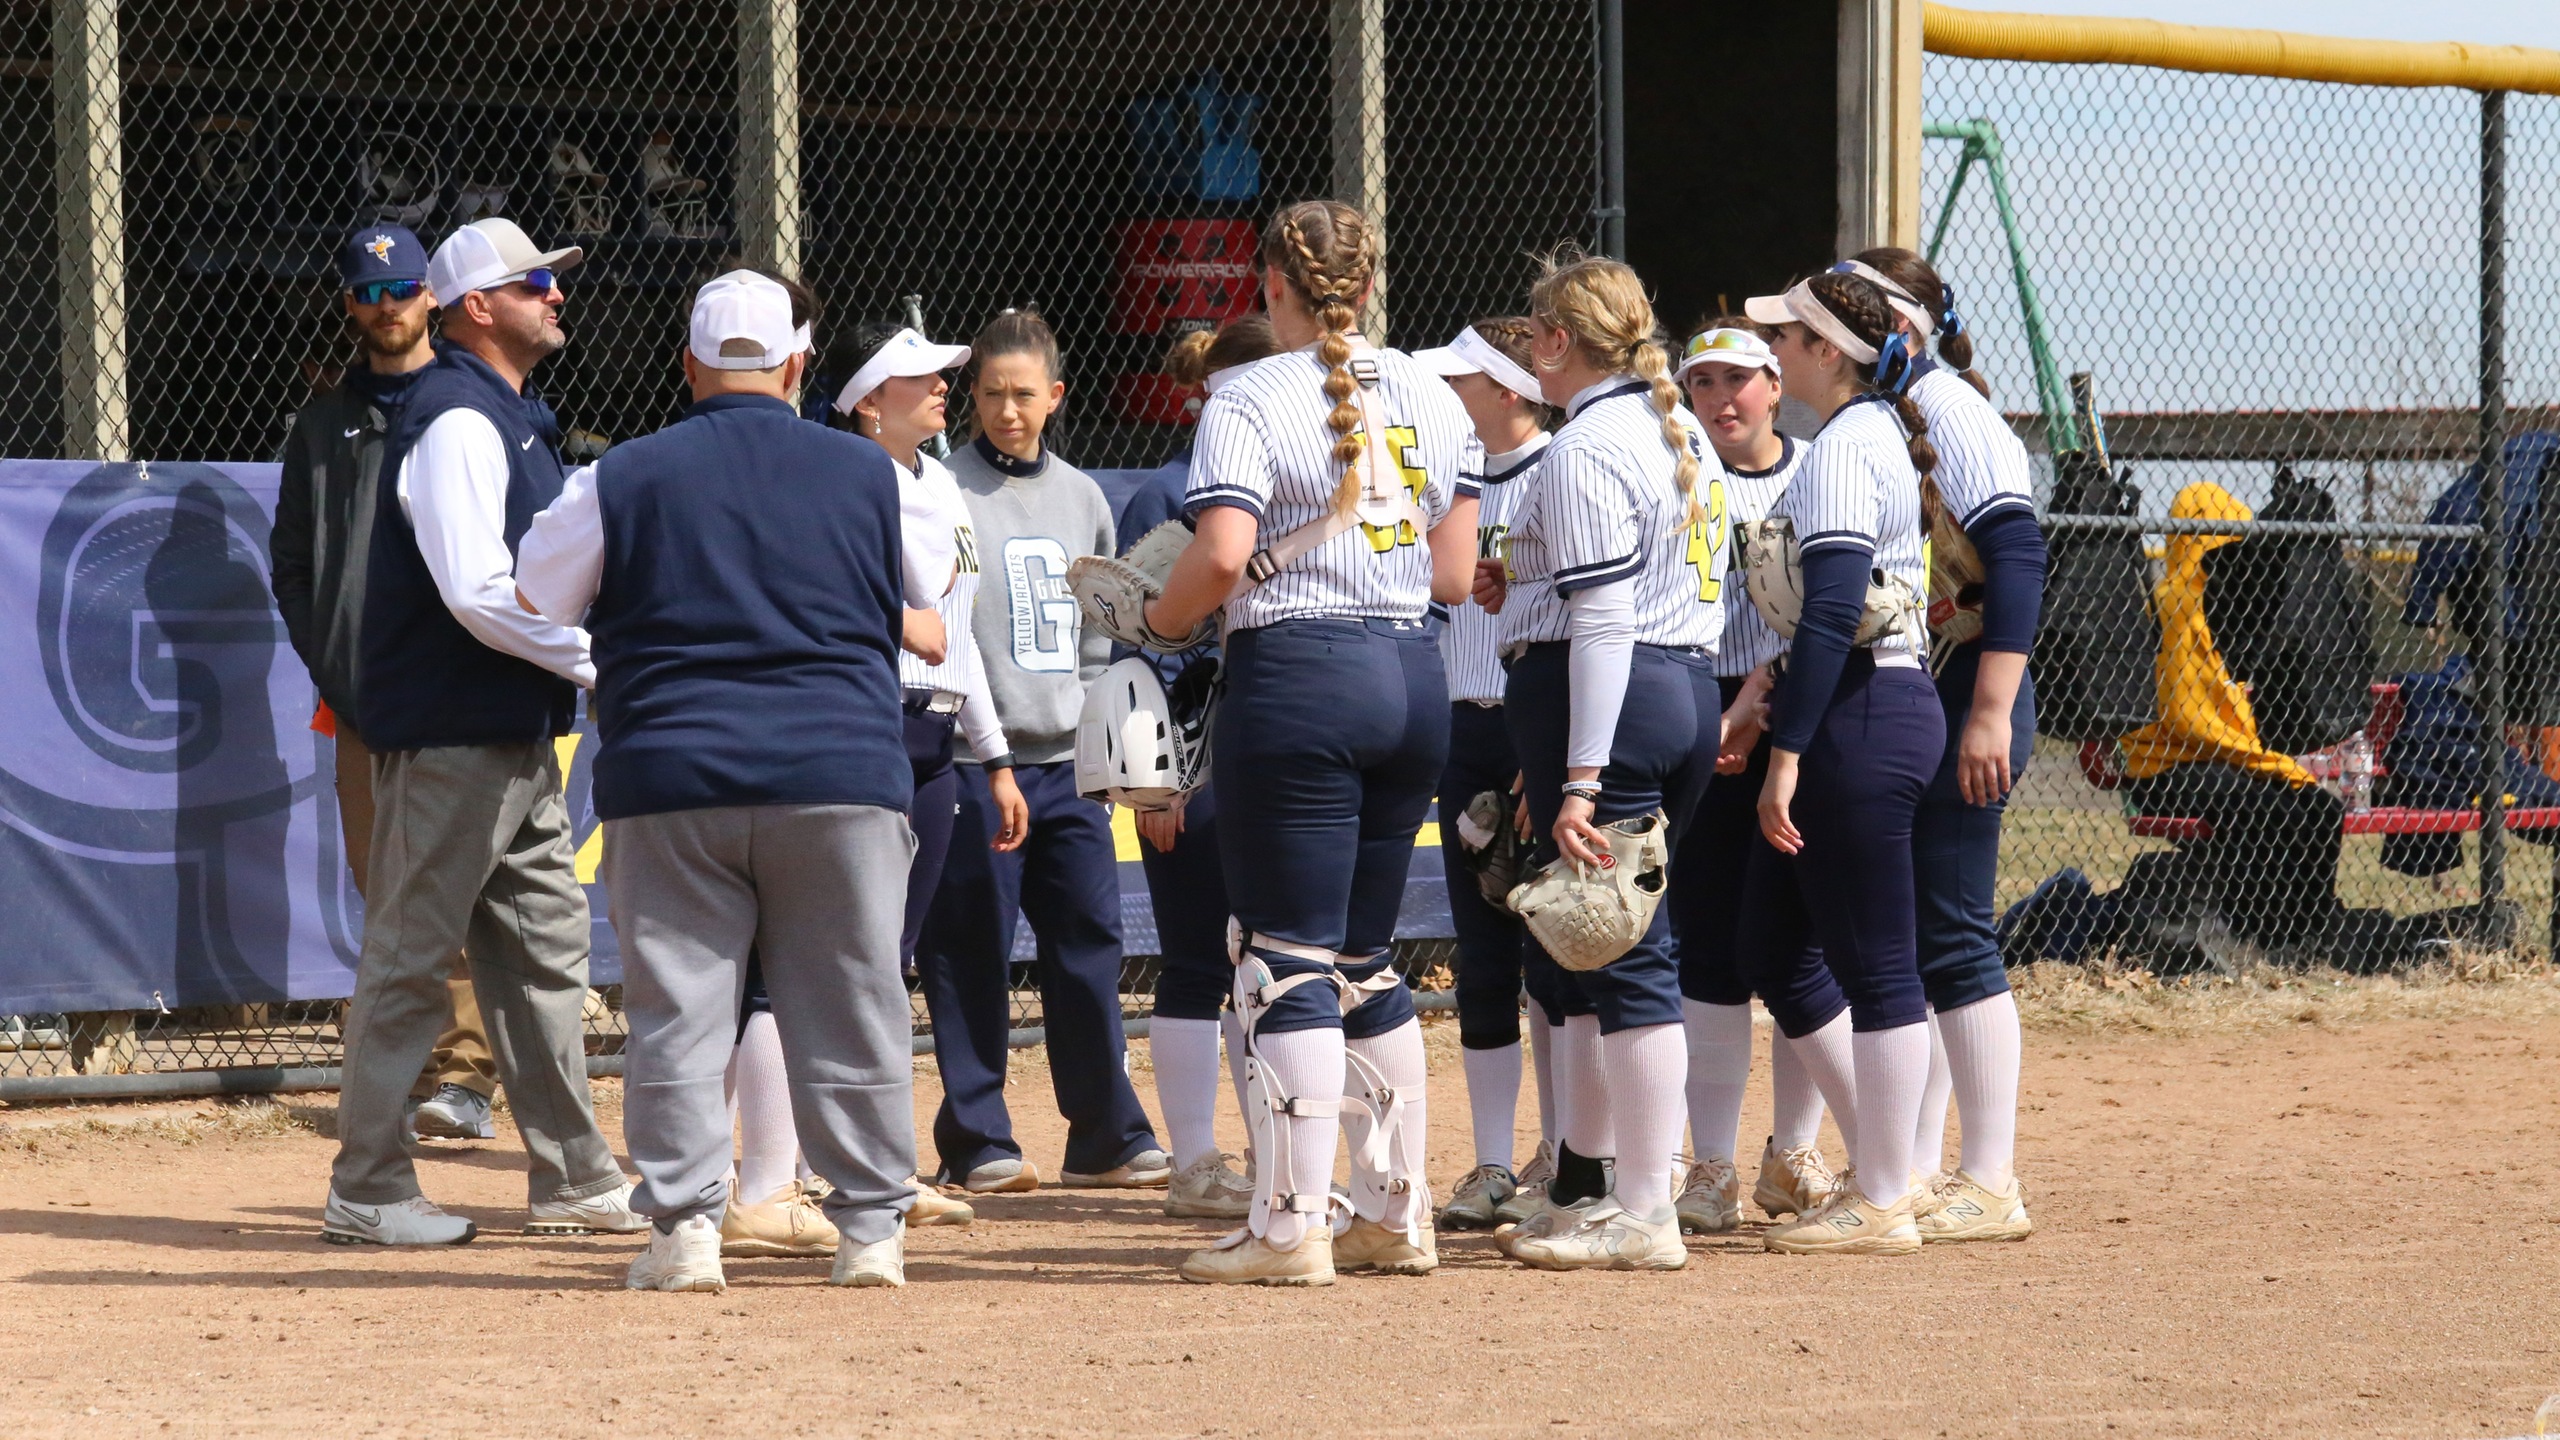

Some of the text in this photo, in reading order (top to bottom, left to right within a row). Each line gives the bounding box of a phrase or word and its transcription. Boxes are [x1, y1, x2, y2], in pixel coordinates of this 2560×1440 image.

[1132, 264, 1248, 278] POWERADE
[1686, 480, 1727, 604] 42
[1008, 553, 1033, 655] YELLOWJACKETS
